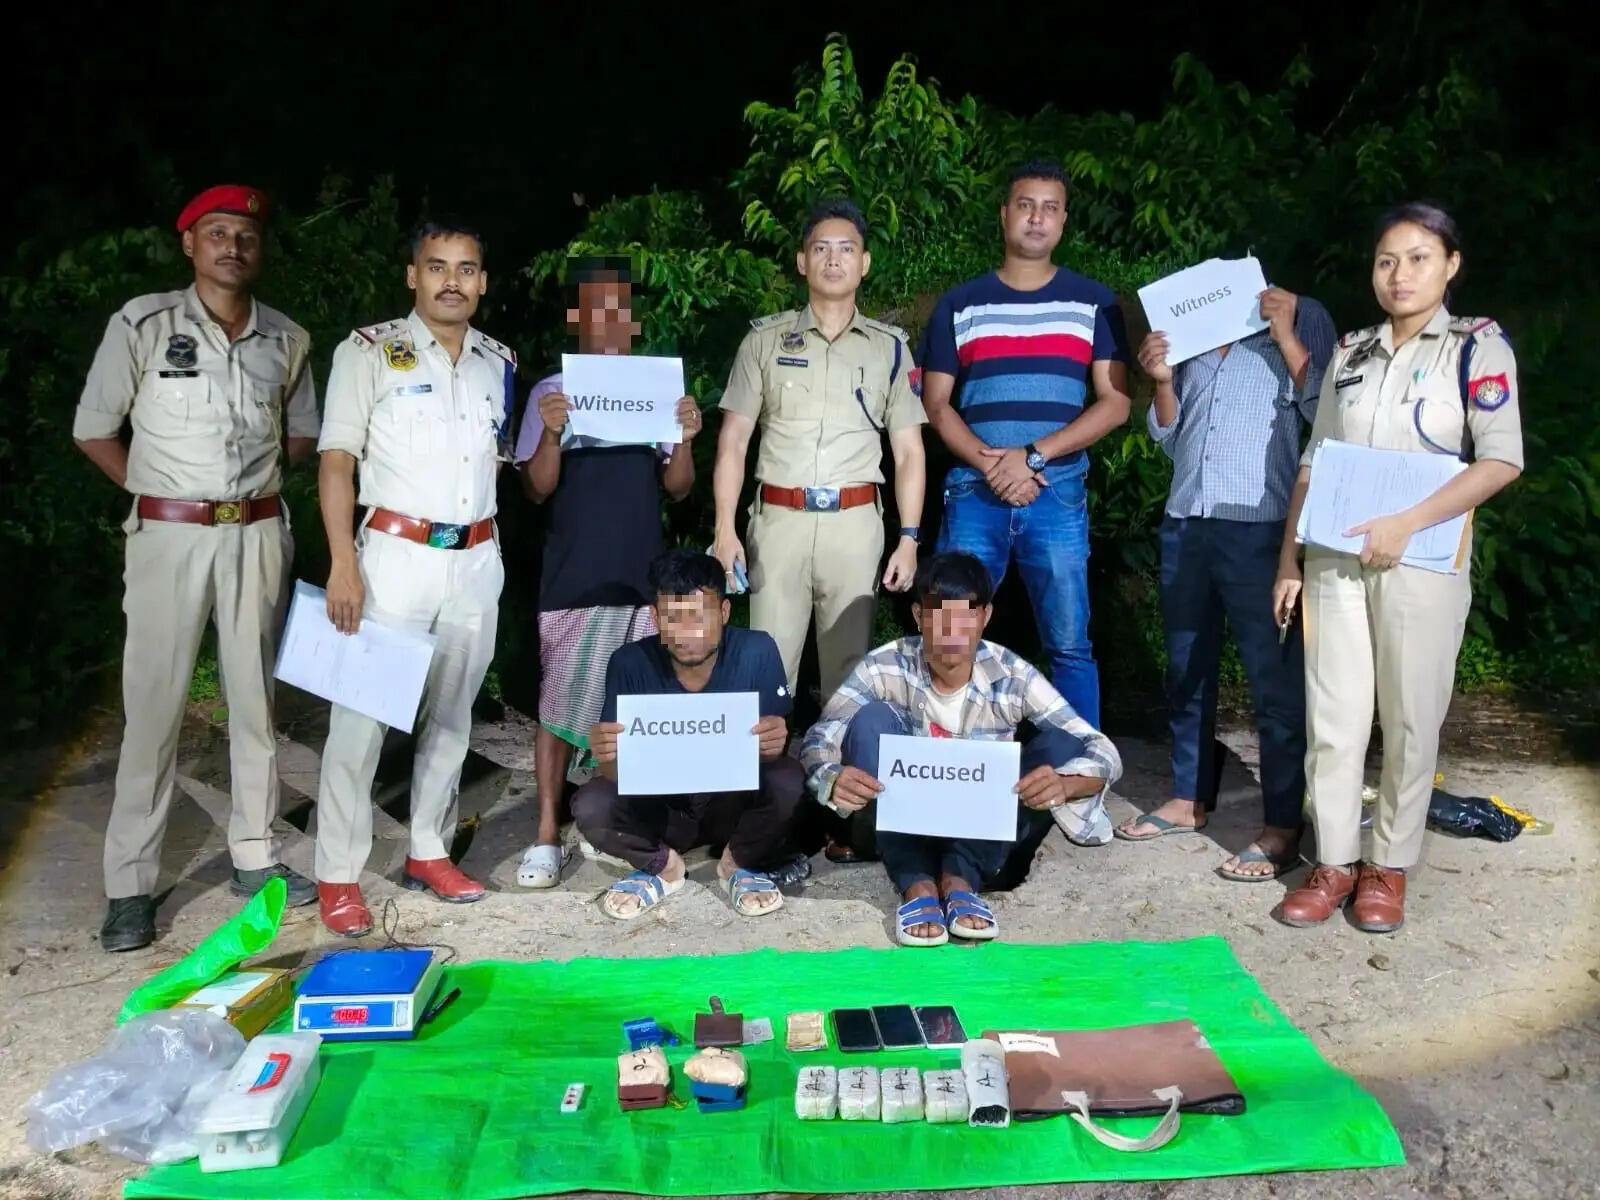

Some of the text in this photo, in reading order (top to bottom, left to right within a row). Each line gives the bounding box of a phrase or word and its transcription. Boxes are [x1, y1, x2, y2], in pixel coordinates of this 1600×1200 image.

[1169, 285, 1232, 318] Witness
[573, 395, 654, 412] Witness
[629, 713, 726, 736] Accused
[889, 758, 985, 783] Accused
